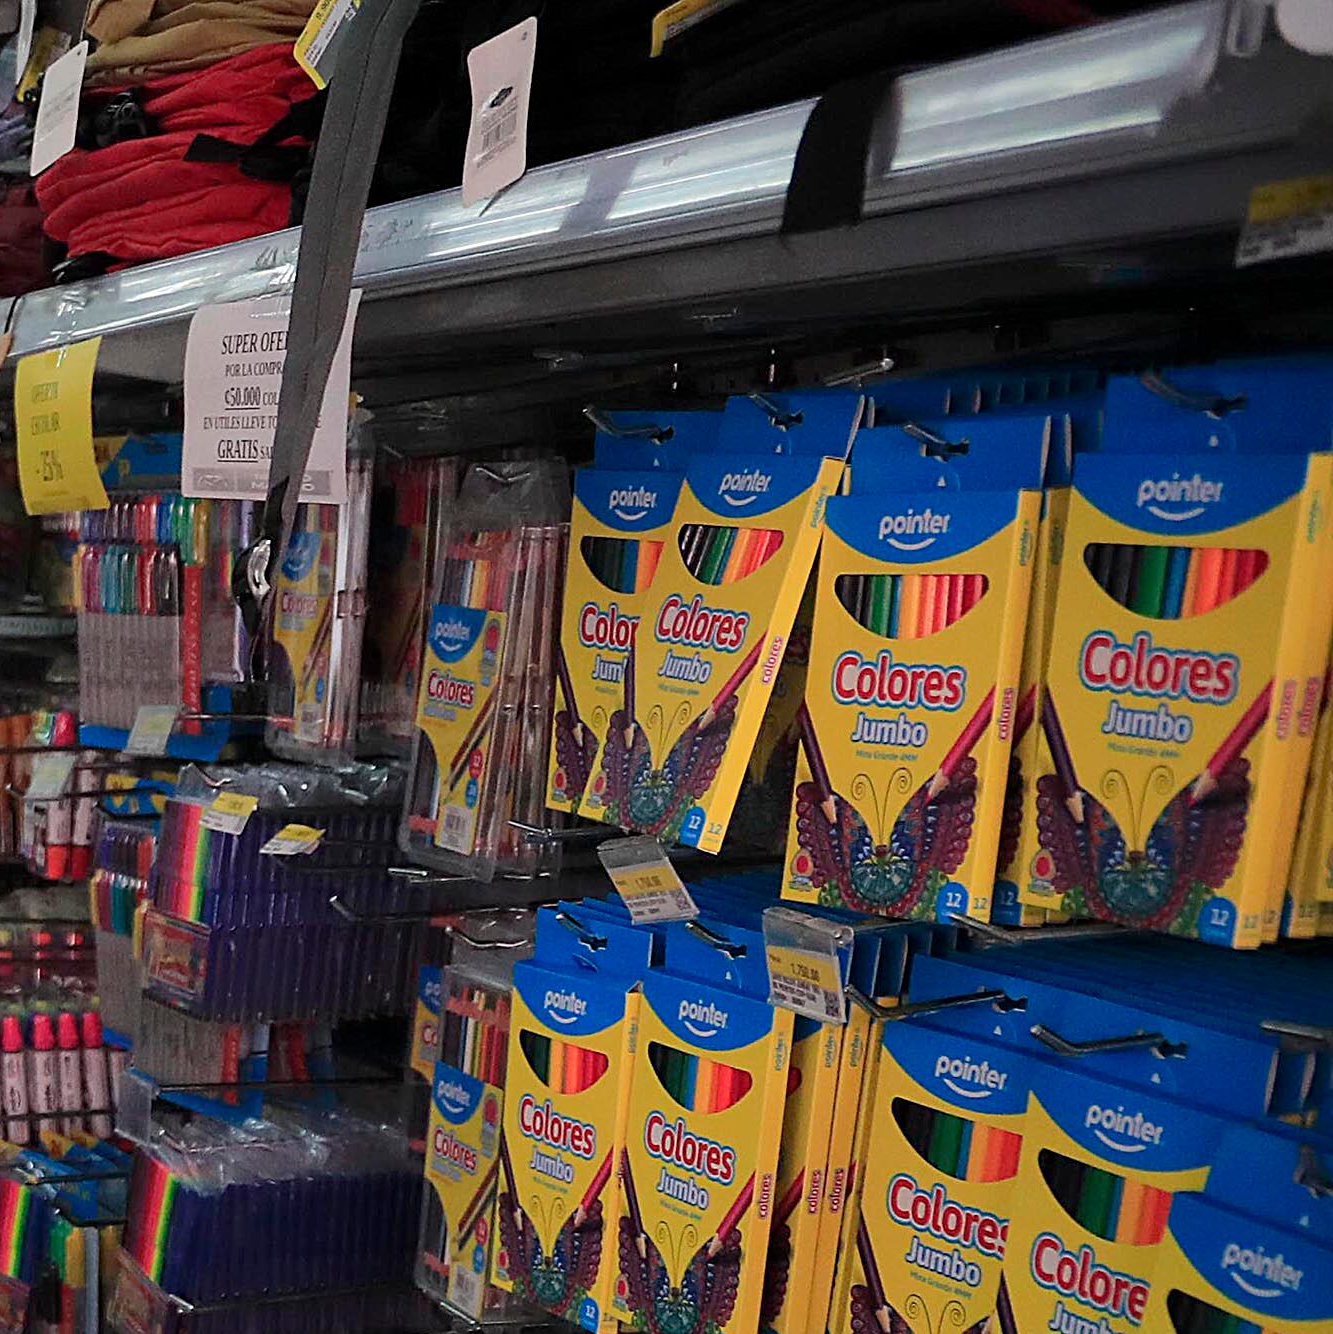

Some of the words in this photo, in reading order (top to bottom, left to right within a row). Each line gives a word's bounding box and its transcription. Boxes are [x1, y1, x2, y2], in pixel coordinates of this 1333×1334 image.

[221, 332, 259, 355] SUPER
[224, 363, 241, 377] POR
[242, 362, 253, 377] LA
[253, 360, 283, 376] COMPR
[203, 416, 214, 430] EN
[214, 416, 240, 430] UTILES
[241, 415, 266, 430] LLEVE
[216, 439, 259, 460] GRATIS
[609, 485, 658, 510] pointer
[718, 469, 771, 495] pointer
[1137, 472, 1224, 508] pointer
[878, 508, 950, 540] pointer
[582, 602, 639, 648] Color
[656, 594, 749, 652] Colores
[592, 653, 627, 682] Jum
[658, 650, 712, 682] Jumbo
[762, 636, 783, 683] colores
[1082, 632, 1237, 702] Colores
[426, 668, 476, 709] Colores
[834, 652, 965, 708] Colores
[851, 711, 928, 747] Jumbo
[1102, 699, 1193, 744] Jumbo
[946, 892, 962, 907] 12
[543, 987, 588, 1018] pointer
[677, 996, 729, 1030] pointer
[935, 1052, 1007, 1091] pointer
[520, 1097, 596, 1159] Colores
[1085, 1103, 1163, 1146] pointer
[434, 1125, 477, 1172] Colores
[529, 1148, 574, 1184] Jumbo
[645, 1114, 736, 1182] Colores
[655, 1171, 710, 1211] Jumbo
[906, 1236, 982, 1287] Jumbo
[1032, 1233, 1150, 1325] Colore
[1221, 1241, 1304, 1292] pointer
